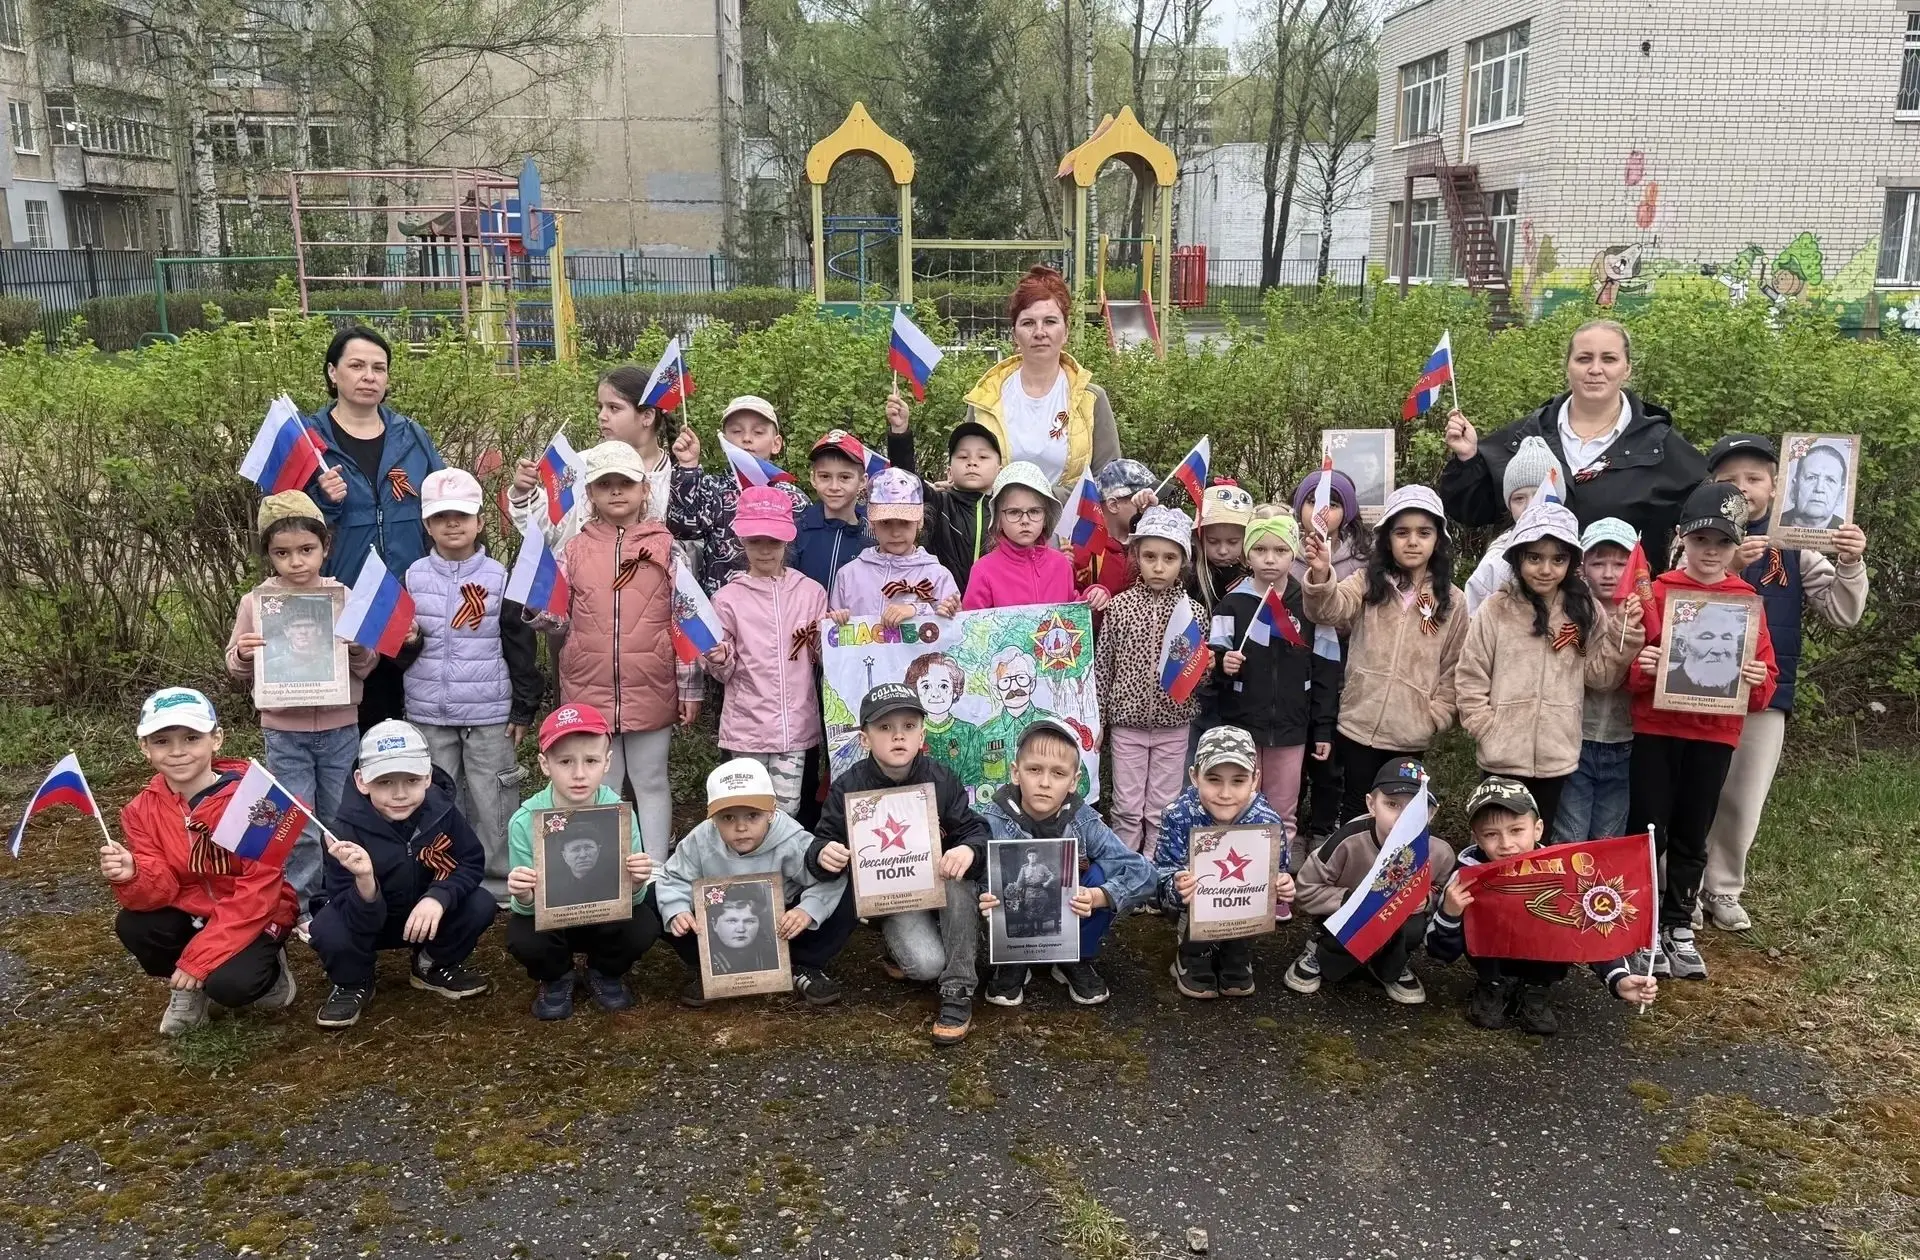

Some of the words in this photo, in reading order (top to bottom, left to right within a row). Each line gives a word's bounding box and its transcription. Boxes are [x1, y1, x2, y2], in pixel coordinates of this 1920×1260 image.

[828, 622, 940, 648] СПАСИБО
[555, 718, 584, 728] TOYOTA
[858, 845, 930, 869] бессмертный
[876, 866, 916, 881] ПОЛК
[1196, 874, 1267, 898] бессмертный
[1212, 896, 1252, 908] ПОЛК
